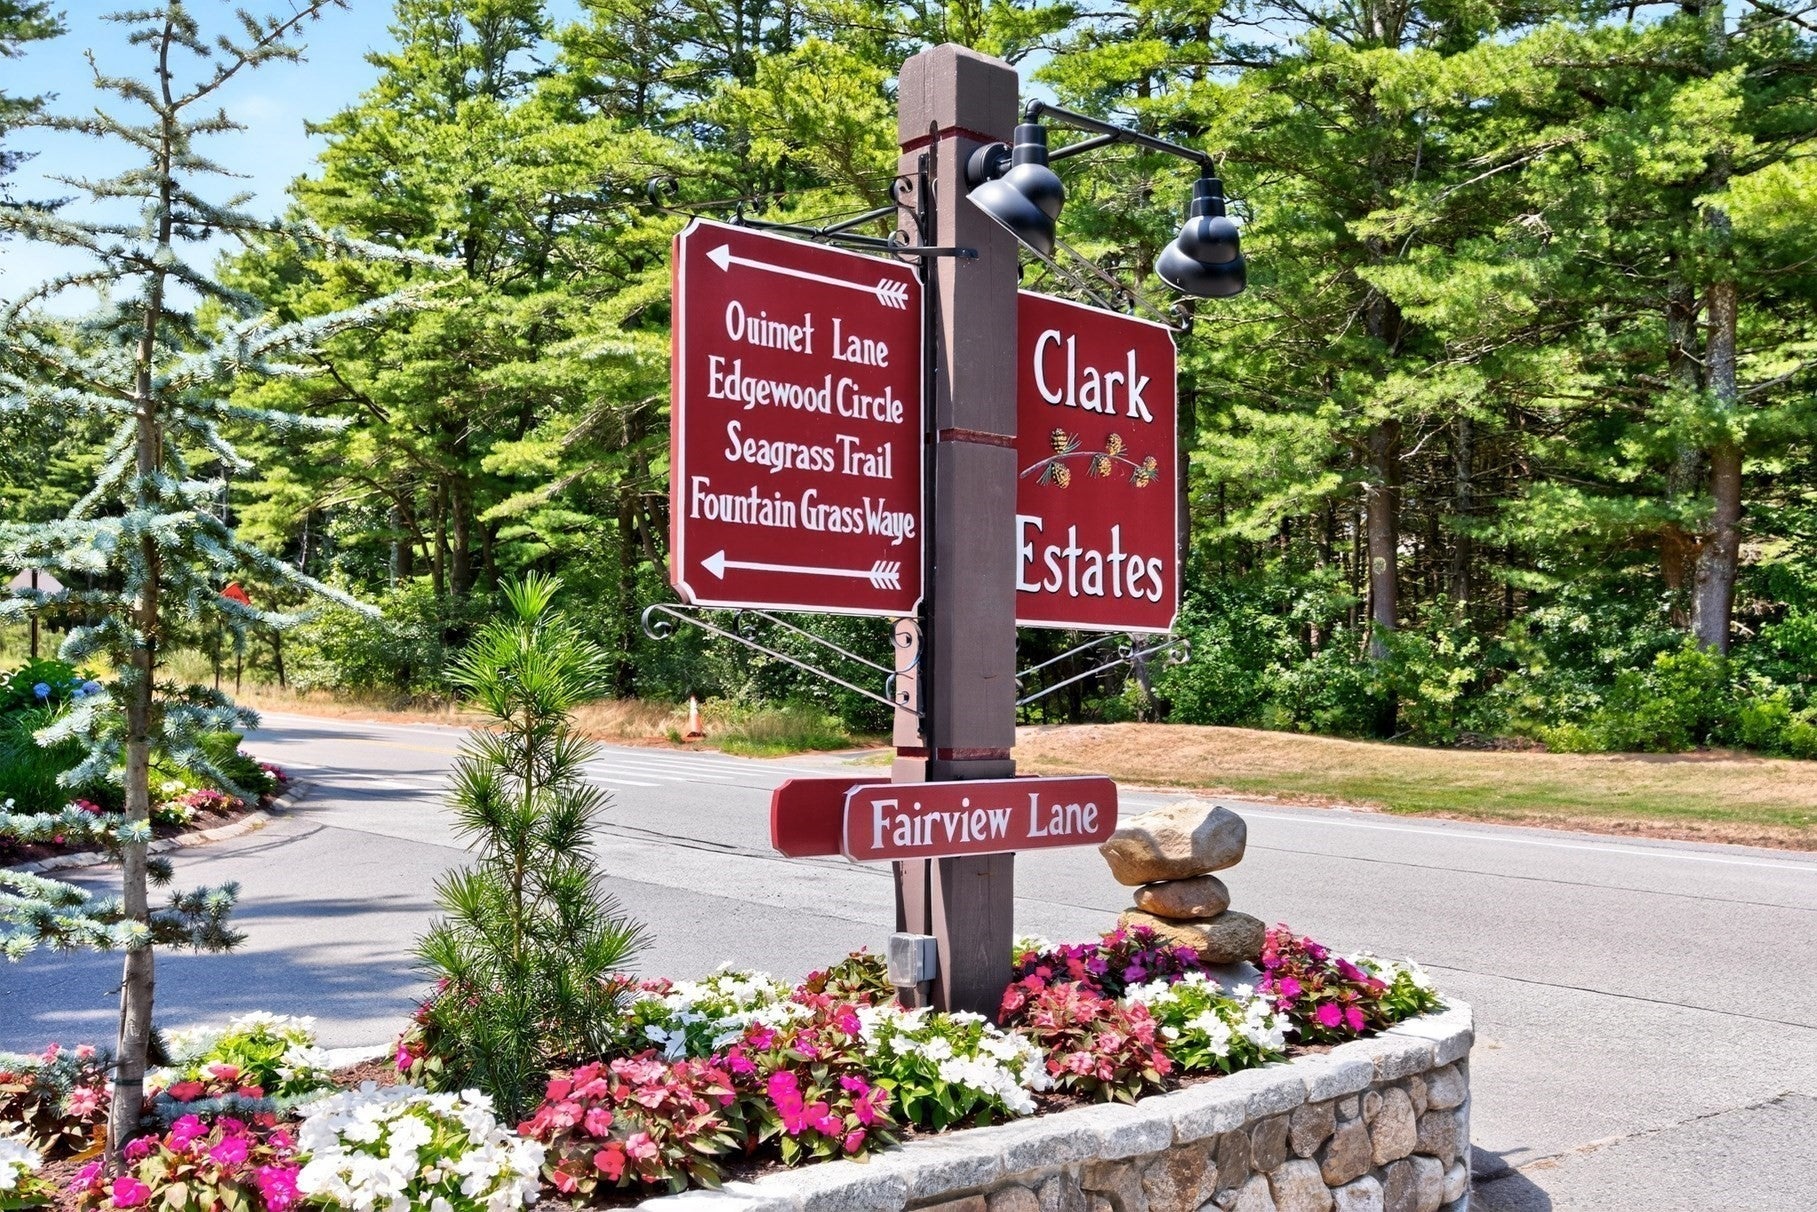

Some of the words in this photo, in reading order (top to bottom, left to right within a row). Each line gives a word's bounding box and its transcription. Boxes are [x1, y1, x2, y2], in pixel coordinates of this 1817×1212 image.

[725, 300, 815, 355] Ouimet
[832, 317, 889, 368] Lane
[707, 354, 832, 415] Edgewood
[836, 377, 904, 424] Circle
[1033, 328, 1154, 424] Clark
[724, 419, 835, 474] Seagrass
[835, 433, 893, 479] Trail
[689, 475, 797, 529] Fountain
[800, 488, 864, 534] Grass
[1015, 514, 1163, 603] Estates
[870, 797, 1013, 850] Fairview
[1026, 792, 1099, 838] Lane
